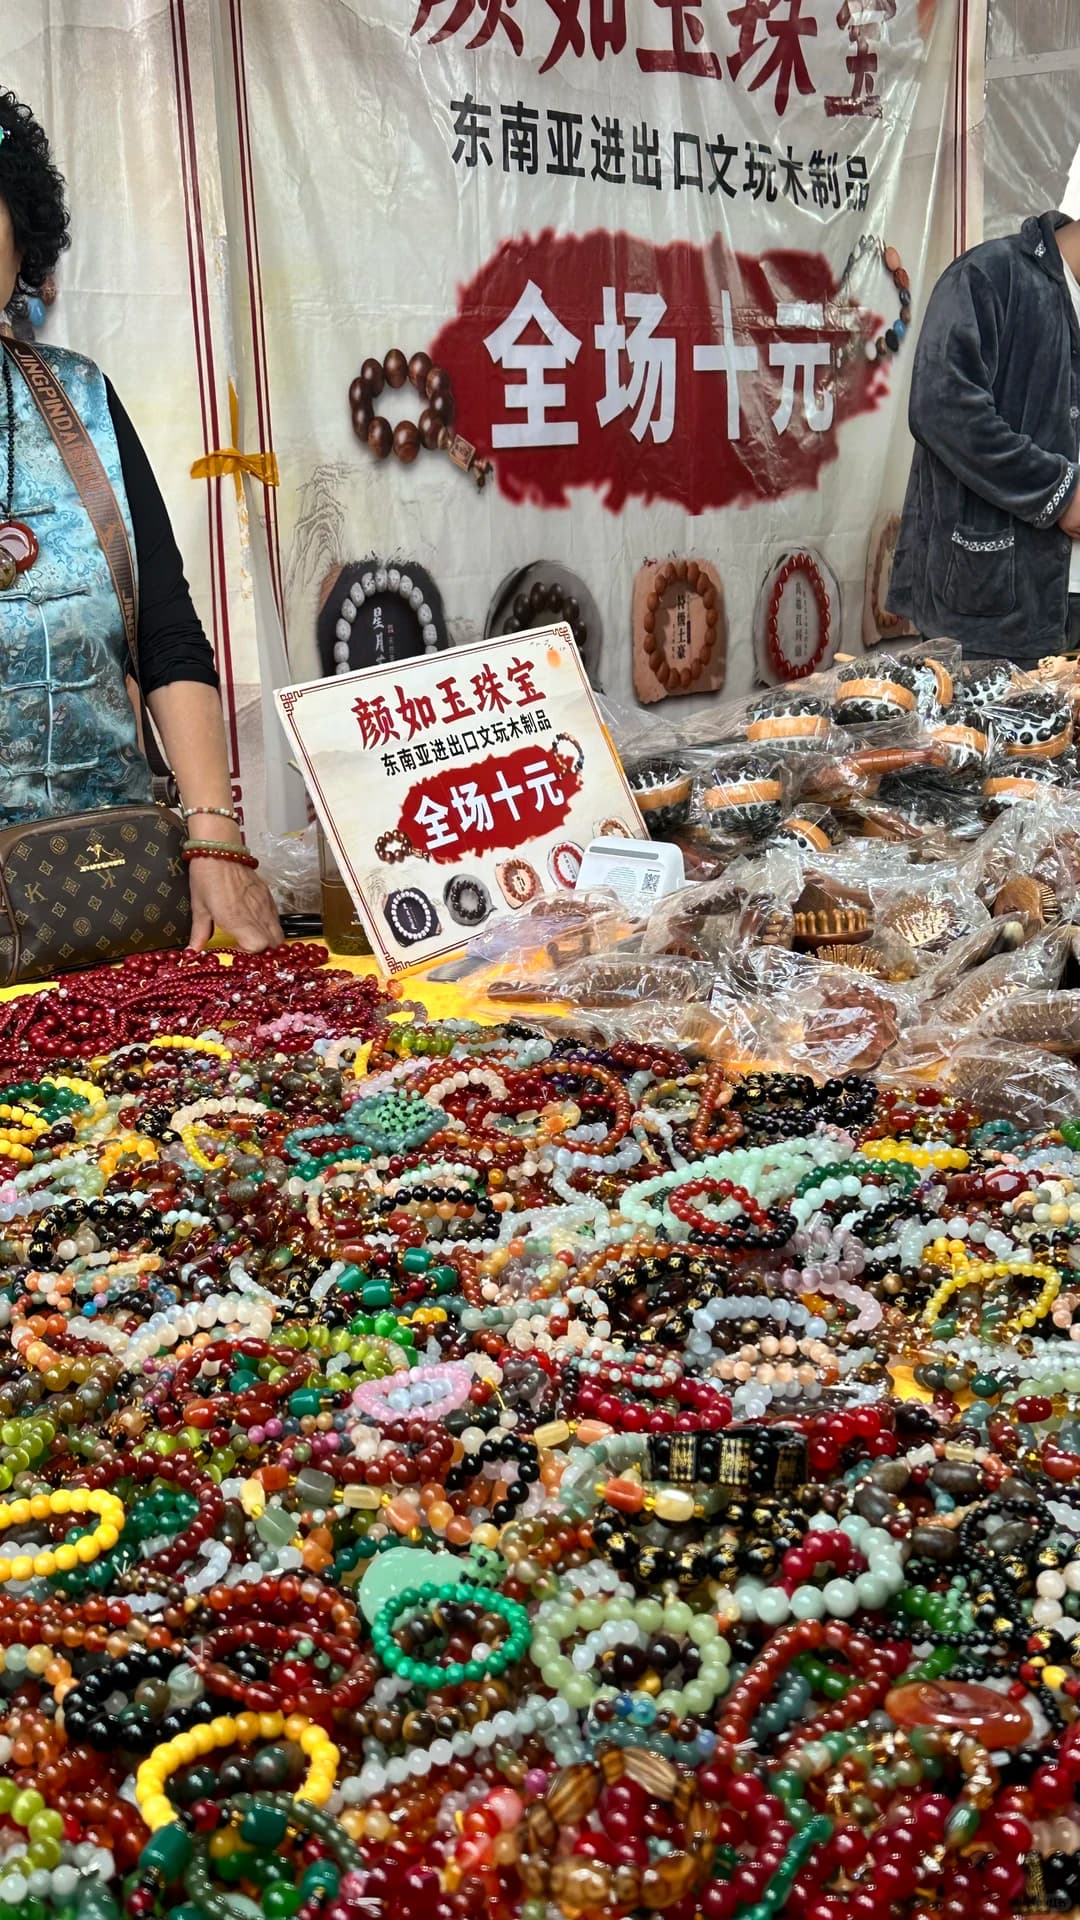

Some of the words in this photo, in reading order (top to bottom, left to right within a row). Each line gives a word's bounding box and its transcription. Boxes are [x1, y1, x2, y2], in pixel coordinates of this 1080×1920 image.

[450, 93, 869, 213] 东南亚进出口文玩木制品
[483, 279, 834, 448] 全场十元
[351, 657, 546, 750] 颜如玉珠宝
[380, 709, 552, 776] 东南亚进出口文玩木制品
[414, 760, 564, 850] 全场十元
